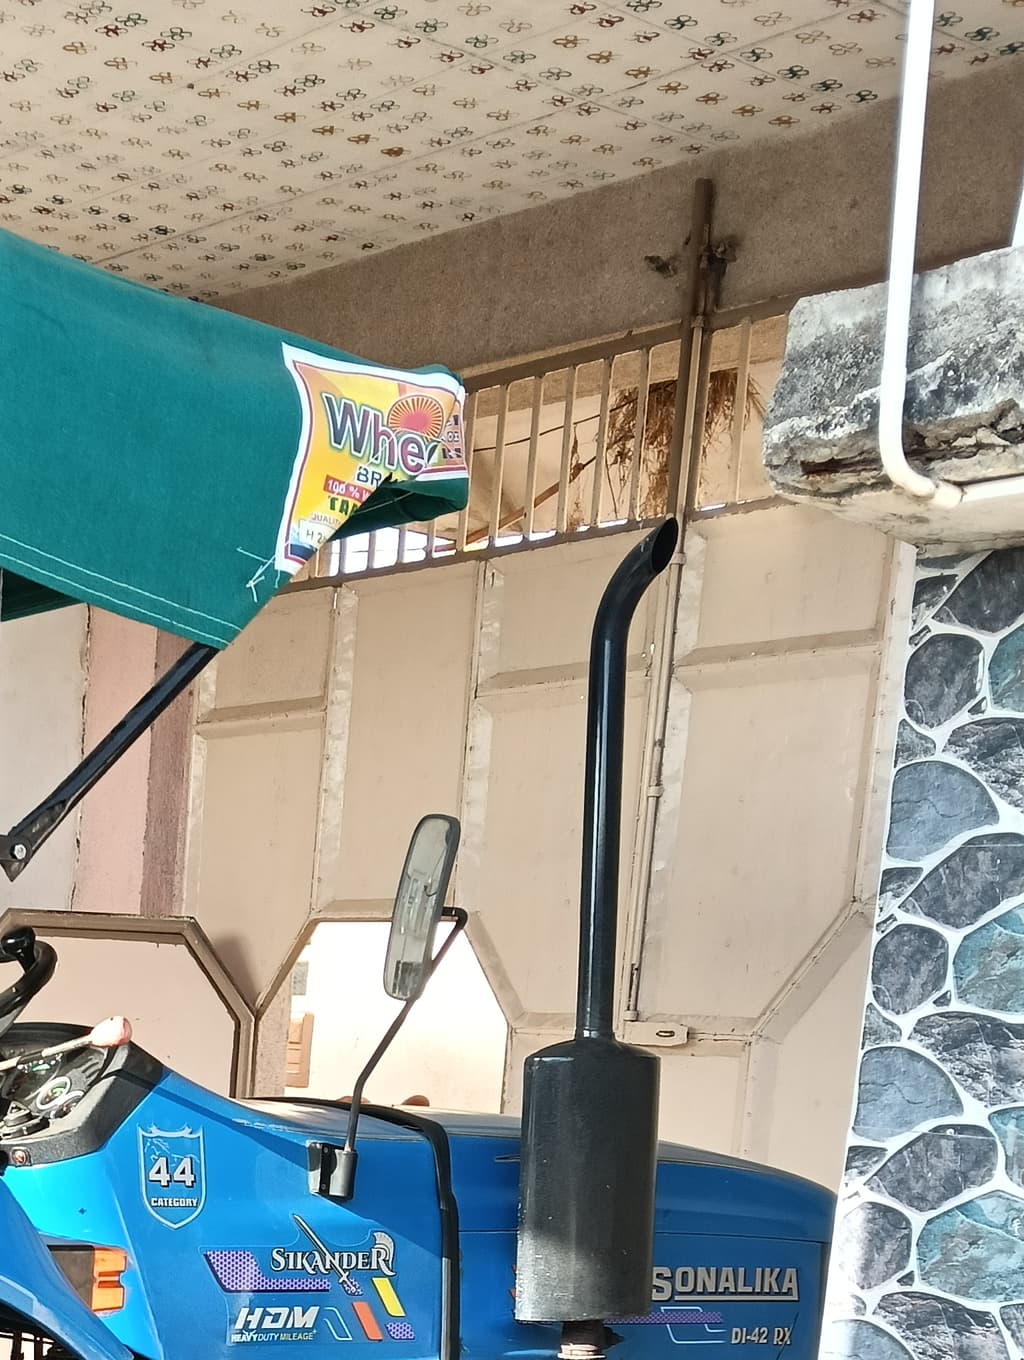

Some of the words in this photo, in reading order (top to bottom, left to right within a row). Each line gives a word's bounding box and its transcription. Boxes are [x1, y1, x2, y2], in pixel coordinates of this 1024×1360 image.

[149, 1157, 194, 1187] 44
[151, 1197, 198, 1207] CATEGORY
[271, 1247, 395, 1276] SIKANDER
[652, 1266, 799, 1300] SONALIKA
[234, 1306, 320, 1329] HDM
[231, 1330, 257, 1342] HEAVY
[257, 1333, 279, 1341] DUTY
[731, 1327, 768, 1344] DI-42
